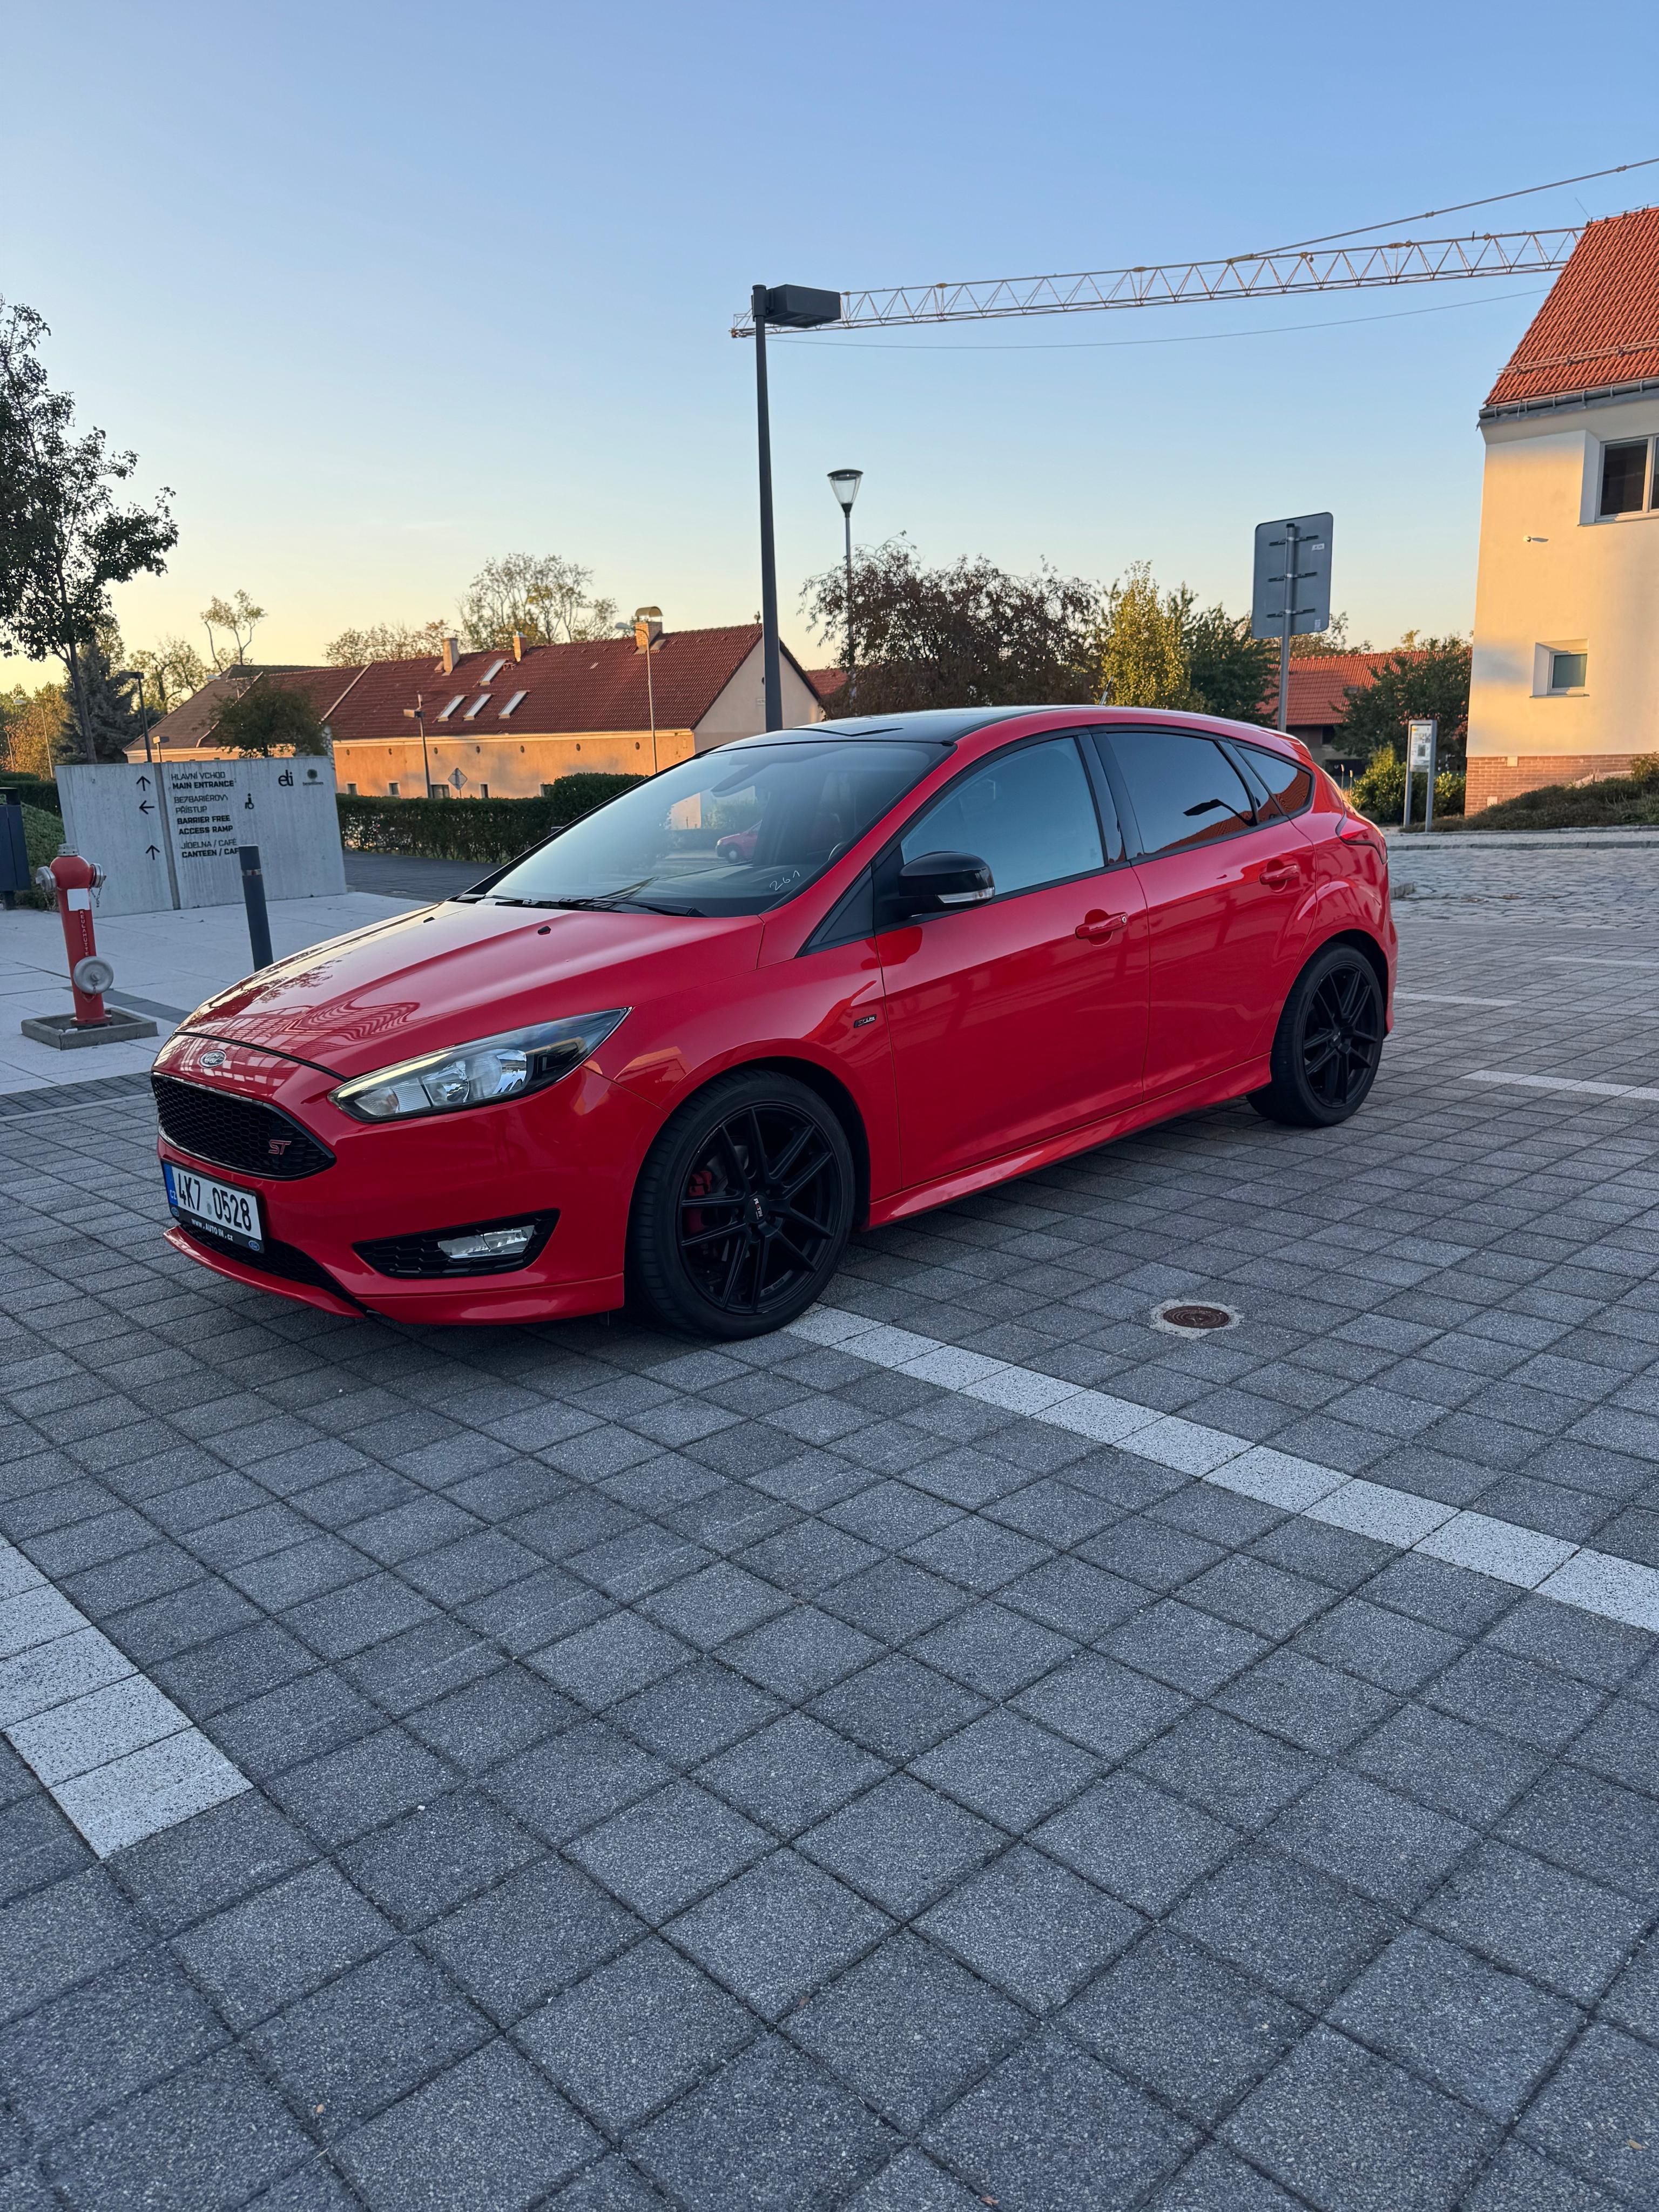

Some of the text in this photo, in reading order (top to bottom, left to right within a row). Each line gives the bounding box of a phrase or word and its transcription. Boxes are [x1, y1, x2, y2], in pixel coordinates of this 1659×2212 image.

[171, 771, 198, 781] HLAVNÍ
[278, 770, 294, 786] eli
[194, 780, 234, 788] ENTRANCE
[177, 816, 210, 825] BARRIER
[179, 827, 210, 835] ACCESS
[218, 838, 237, 846] CAFÉ
[182, 849, 217, 858] CANTEEN
[268, 1139, 292, 1155] ST
[170, 1173, 252, 1232] CZ 4K7 0528
